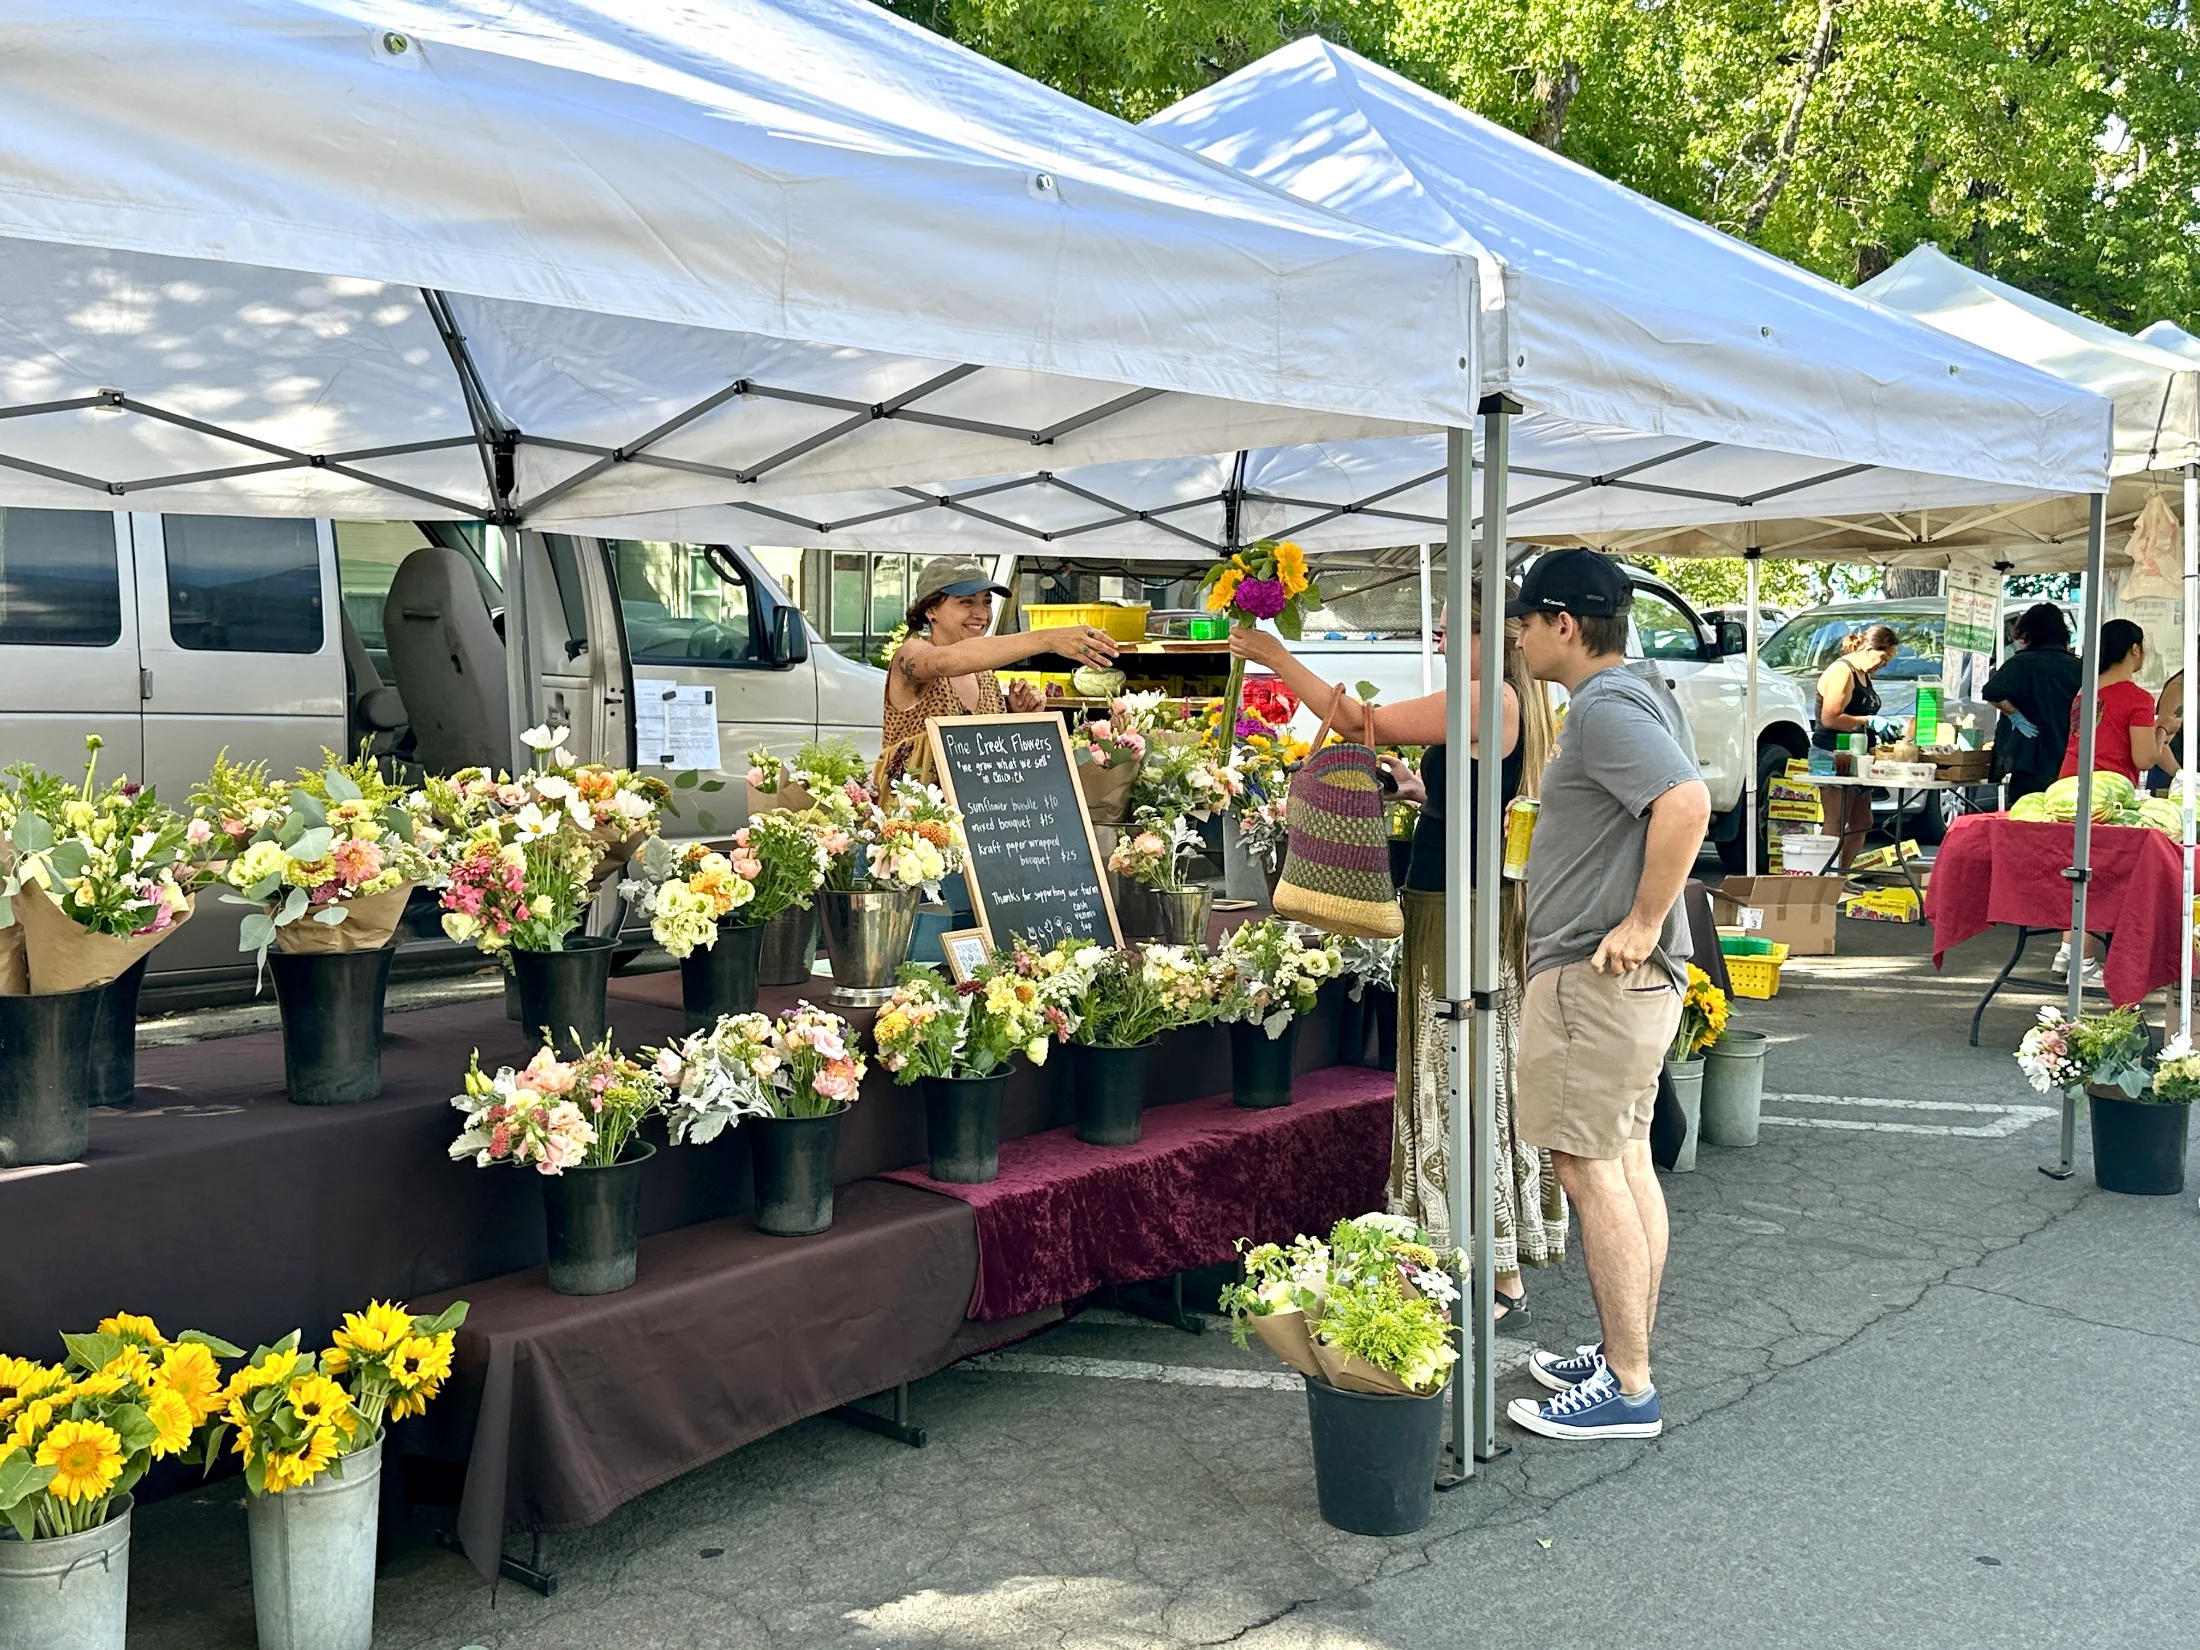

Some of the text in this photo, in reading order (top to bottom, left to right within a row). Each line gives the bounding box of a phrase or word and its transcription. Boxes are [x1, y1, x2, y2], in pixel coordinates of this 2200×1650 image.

[946, 732, 1052, 757] Pine Creek Flowers
[975, 762, 992, 776] grow
[996, 757, 1017, 770] what
[1020, 758, 1032, 769] we
[982, 775, 990, 784] in
[1011, 797, 1039, 811] bundle
[1043, 794, 1059, 810] $10
[971, 813, 1054, 833] mixed bouquet $15
[1019, 848, 1077, 872] bouquet $25
[991, 882, 1099, 905] Thanks for supporting our farm
[1080, 921, 1092, 933] tap
